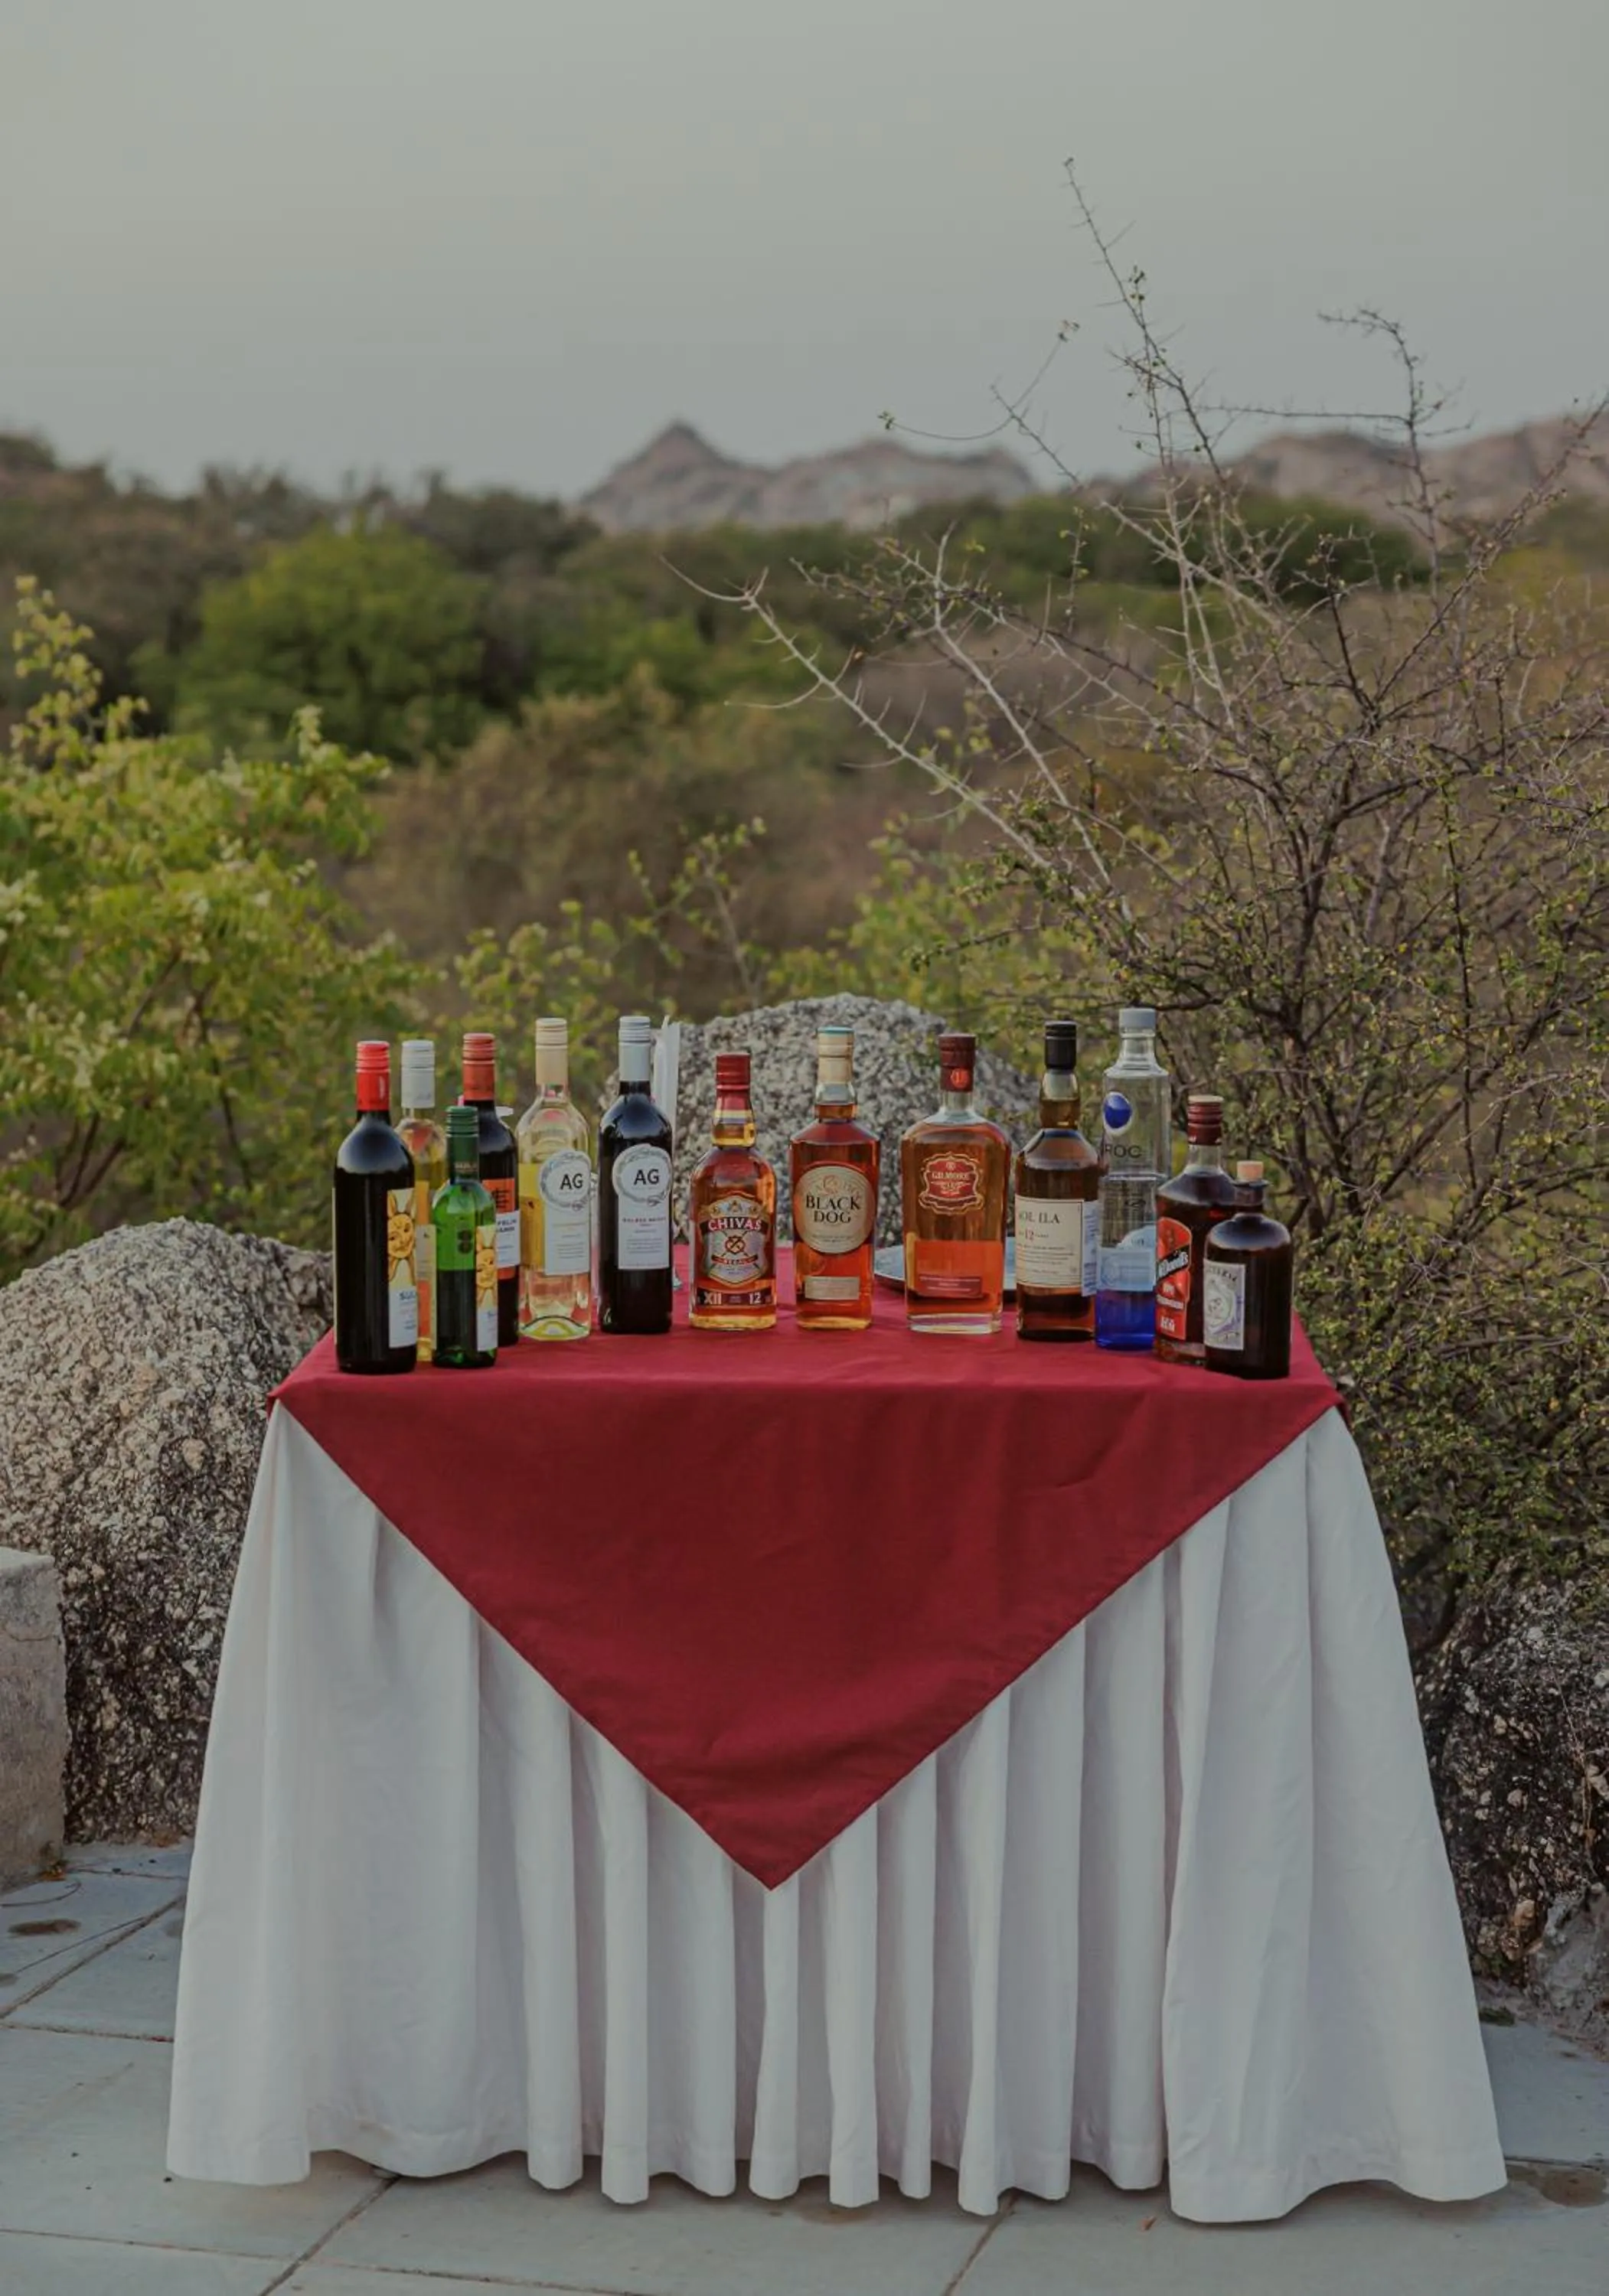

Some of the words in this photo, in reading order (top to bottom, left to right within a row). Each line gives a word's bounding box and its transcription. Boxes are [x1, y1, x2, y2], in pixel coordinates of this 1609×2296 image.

[560, 1173, 583, 1190] AG
[634, 1169, 659, 1185] AG
[806, 1195, 860, 1210] BLACK
[708, 1218, 762, 1231] CHIVAS
[814, 1212, 851, 1223] DOG
[704, 1291, 723, 1305] XII
[749, 1292, 761, 1304] 12
